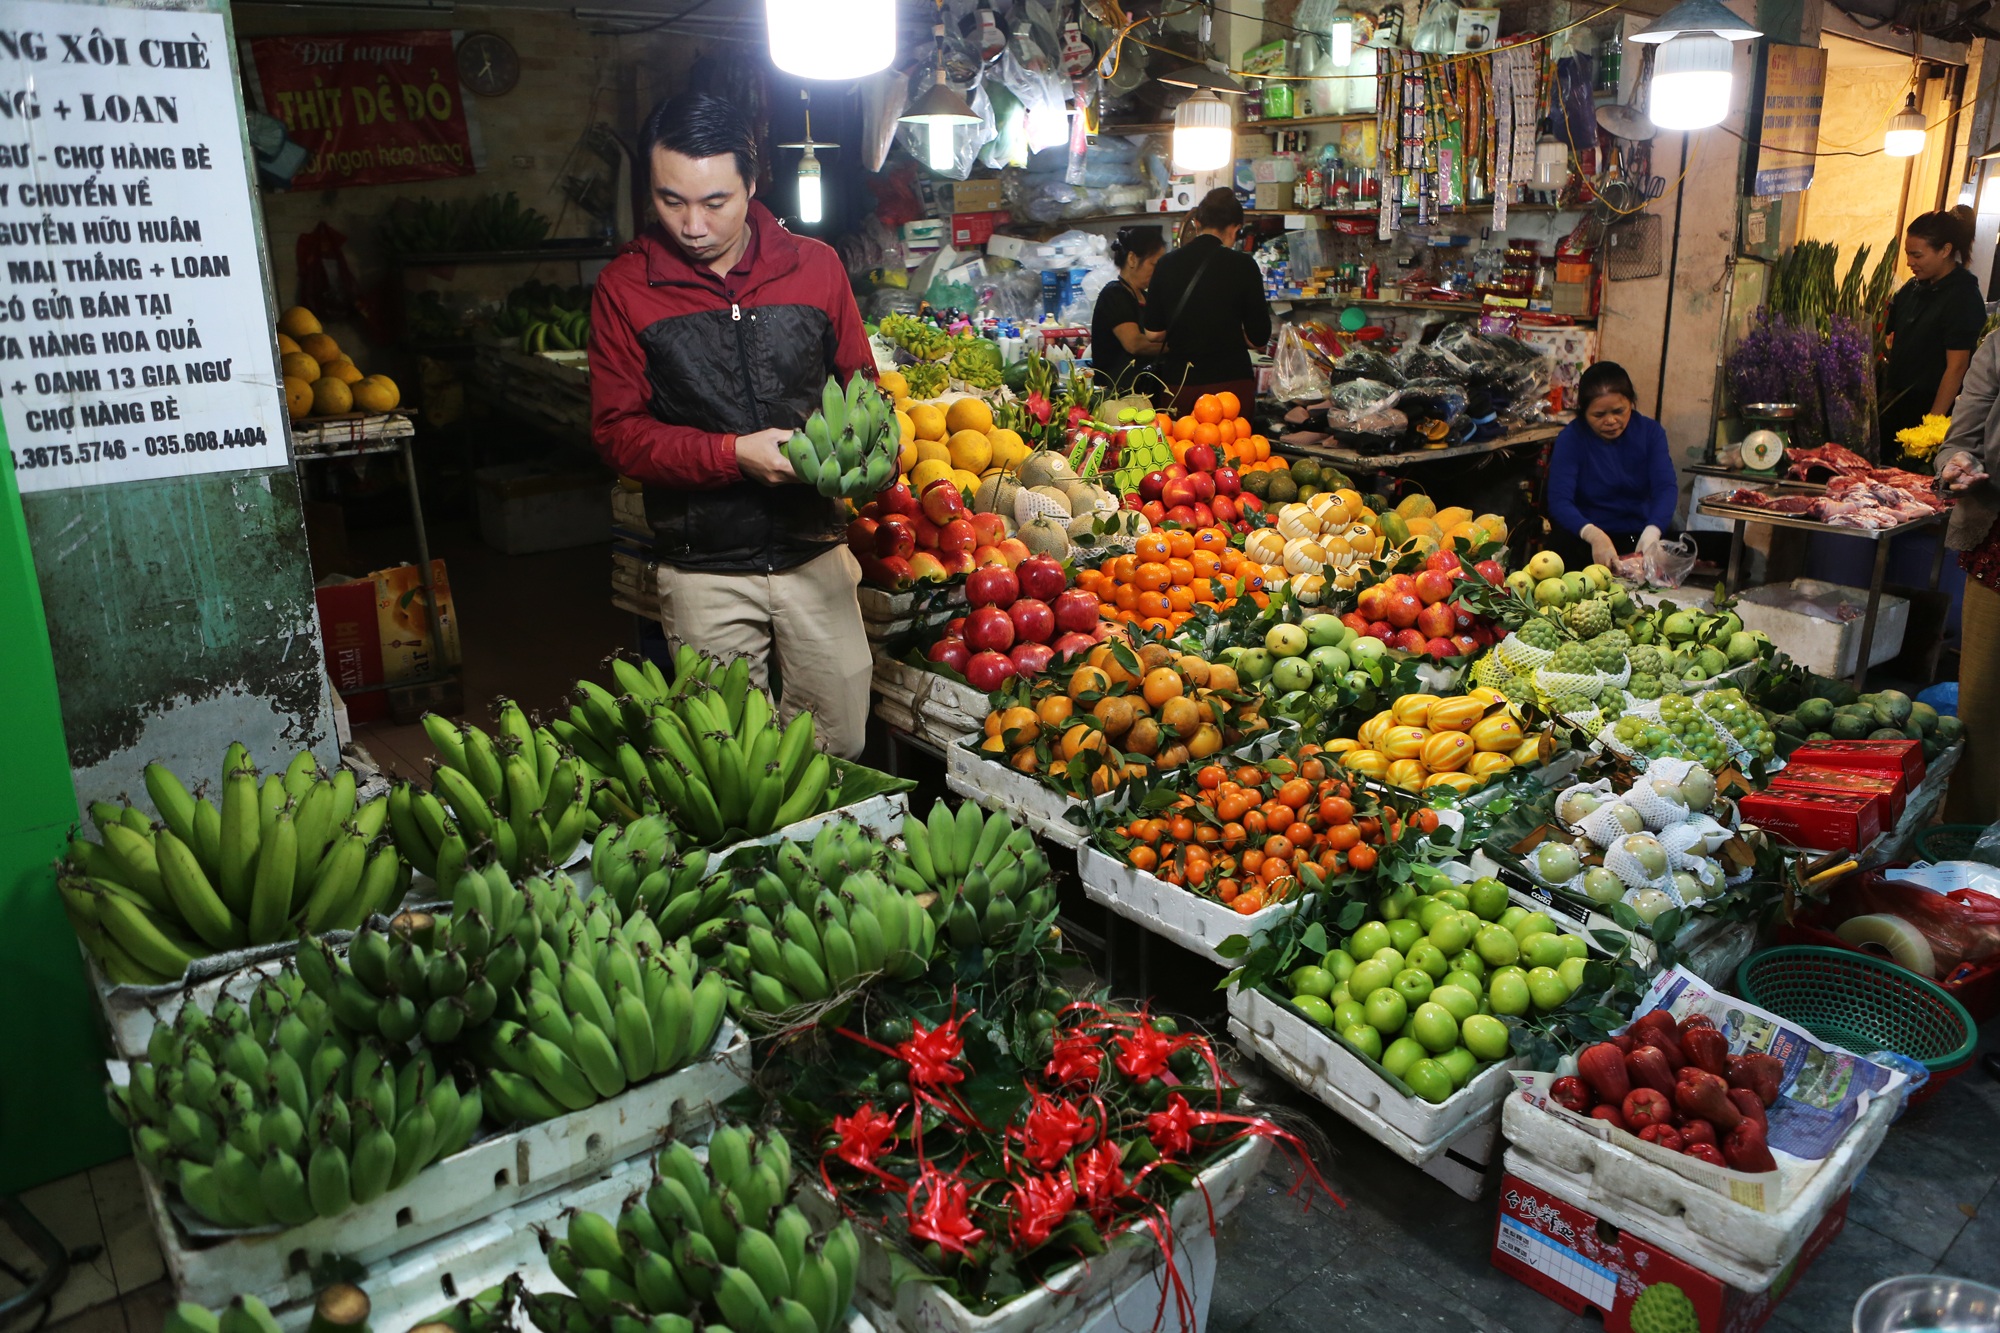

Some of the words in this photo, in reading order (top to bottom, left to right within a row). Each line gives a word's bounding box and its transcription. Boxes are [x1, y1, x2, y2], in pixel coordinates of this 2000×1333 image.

[57, 27, 131, 66] XÔI
[139, 32, 210, 70] CHÈ
[353, 43, 415, 66] ngay
[54, 100, 71, 121] +
[80, 93, 179, 123] LOAN
[276, 75, 344, 142] THỊT
[351, 73, 397, 126] DÊ
[401, 67, 453, 122] ĐỎ
[54, 145, 105, 174] CHỢ
[111, 143, 177, 170] HÀNG
[182, 143, 212, 170] BÈ
[326, 148, 376, 177] ngon
[18, 175, 118, 207] CHUYỂN
[123, 176, 153, 207] VỀ
[83, 215, 132, 244] HỮU
[138, 216, 201, 243] HUÂN
[63, 252, 143, 283] THẮNG
[150, 264, 165, 277] +
[171, 255, 231, 279] LOAN
[32, 288, 75, 320] GỬI
[80, 291, 130, 318] BÁN
[135, 293, 173, 319] TẠI
[29, 331, 97, 359] HÀNG
[102, 330, 151, 354] HOA
[156, 319, 202, 352] QUẢ
[11, 381, 27, 395] +
[34, 369, 101, 395] OANH
[106, 367, 136, 390] 13
[185, 358, 232, 385] NGƯ
[25, 406, 75, 435] CHỢ
[81, 401, 146, 428] HÀNG
[150, 396, 180, 422] BÈ
[144, 427, 267, 457] 035.608.4404
[1768, 817, 1799, 828] Cherries
[1531, 891, 1552, 906] costa
